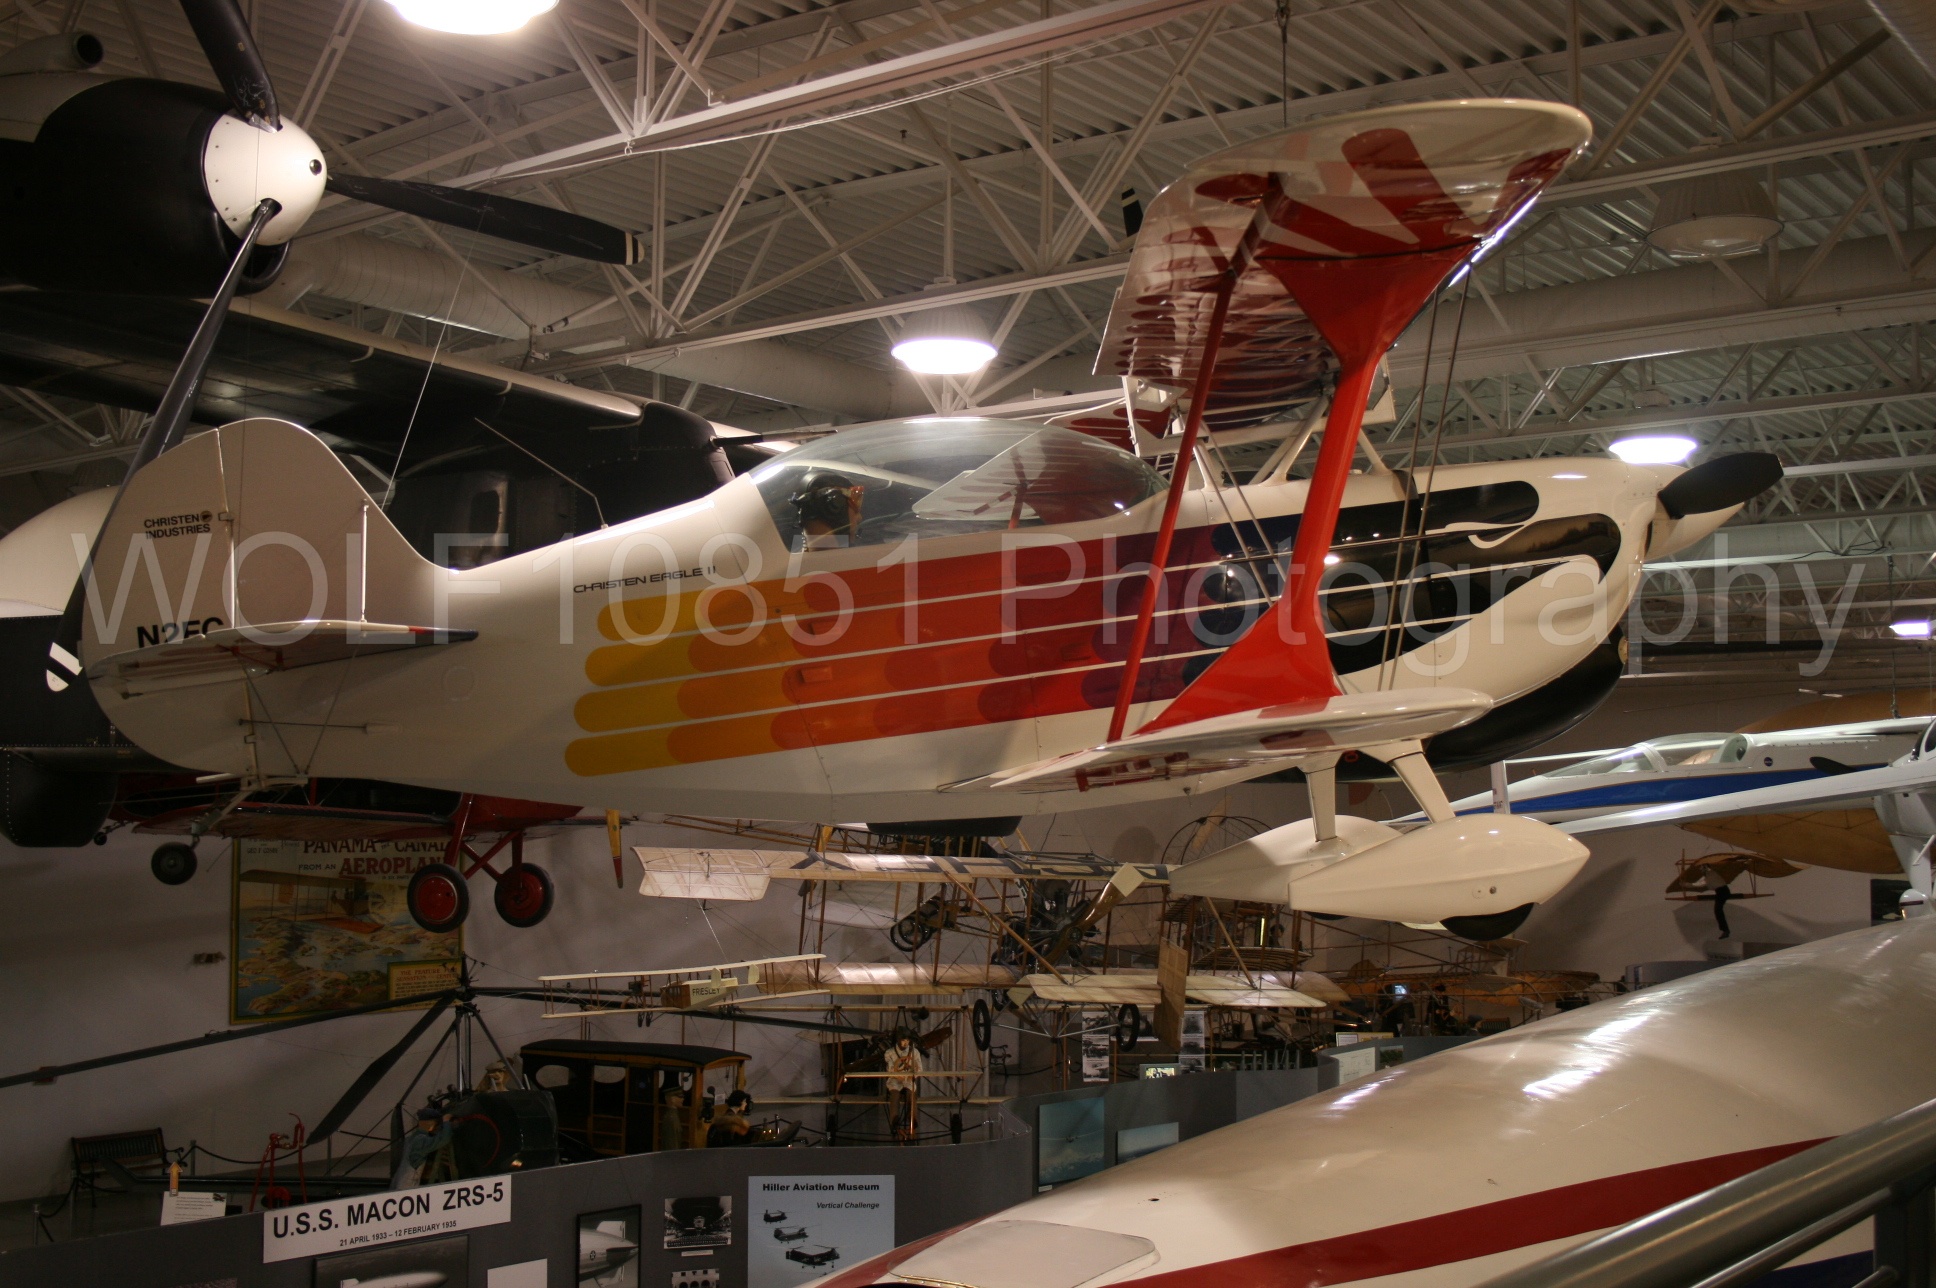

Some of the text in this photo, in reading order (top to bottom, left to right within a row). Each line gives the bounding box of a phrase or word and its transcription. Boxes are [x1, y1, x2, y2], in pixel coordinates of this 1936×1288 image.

[144, 513, 200, 529] CHRISTEN
[146, 523, 211, 540] INDUSTRIES
[573, 576, 647, 594] CHRISTEN
[649, 567, 703, 583] EAGLE
[304, 838, 377, 853] PANAMA
[298, 863, 322, 871] FROM
[762, 1183, 880, 1191] Hiller Aviation Museum
[273, 1181, 504, 1239] U.S.S. MACON ZRS-5
[339, 1238, 348, 1247] 21
[349, 1235, 370, 1246] APRIL
[372, 1231, 388, 1242] 1933
[394, 1229, 402, 1238] 12
[403, 1222, 441, 1236] FEBRUARY
[441, 1219, 457, 1230] 1935
